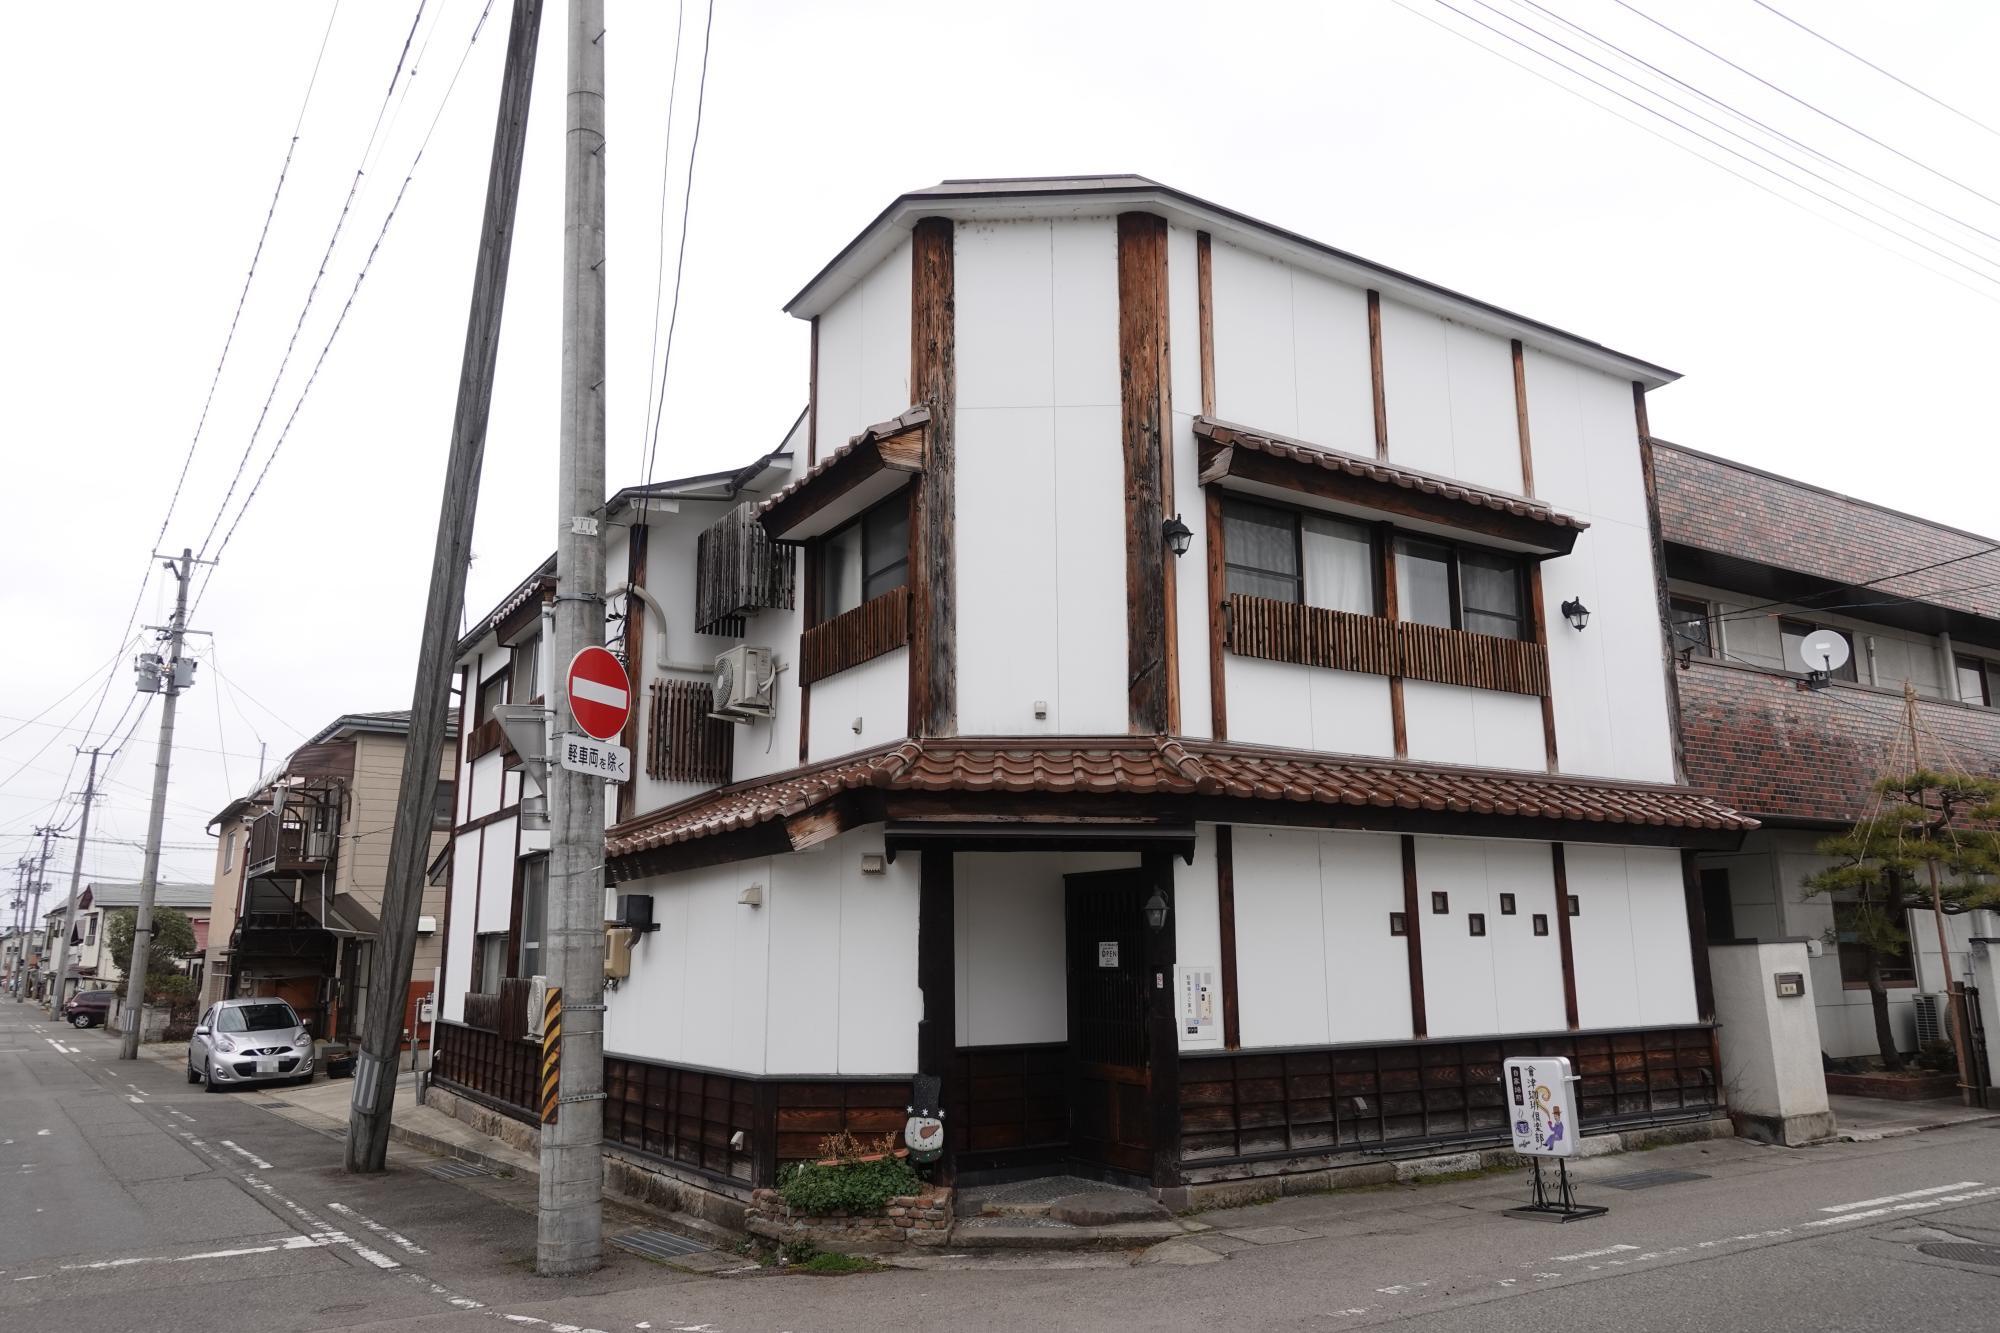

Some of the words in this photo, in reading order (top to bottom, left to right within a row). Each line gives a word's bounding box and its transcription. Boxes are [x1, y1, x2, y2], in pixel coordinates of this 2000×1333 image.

[568, 743, 624, 774] 軽車両を除く
[1102, 950, 1117, 958] OPEN
